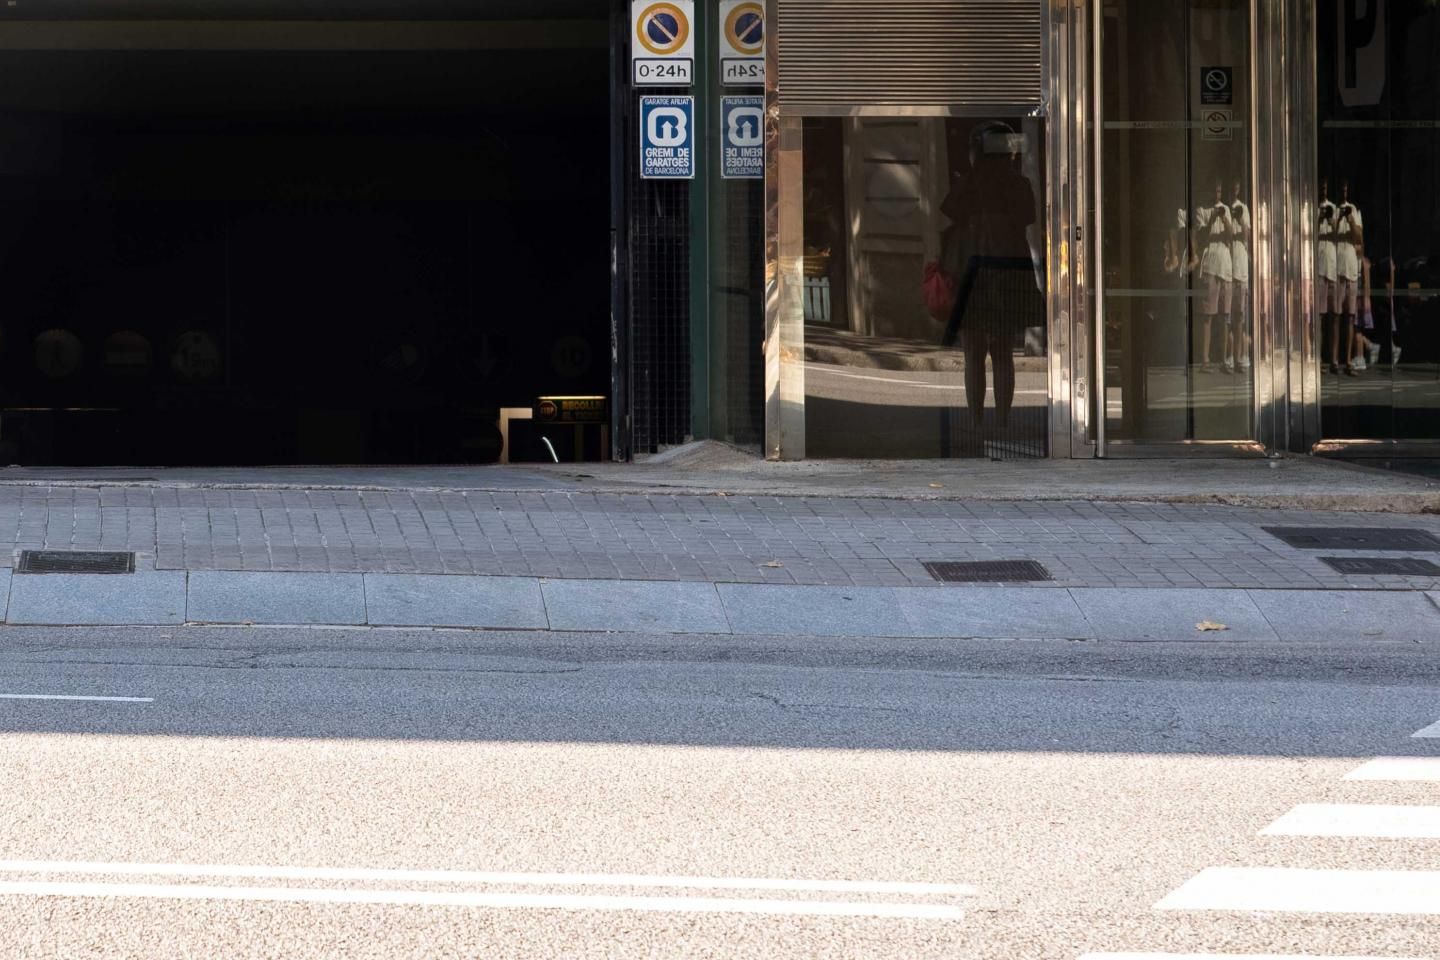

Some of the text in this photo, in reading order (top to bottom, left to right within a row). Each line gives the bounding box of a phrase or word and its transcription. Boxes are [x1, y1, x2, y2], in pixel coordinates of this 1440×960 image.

[639, 64, 687, 77] 0-24h
[645, 147, 690, 157] GREMI DE
[645, 157, 690, 167] GARATGES
[654, 167, 689, 175] BARCELONA
